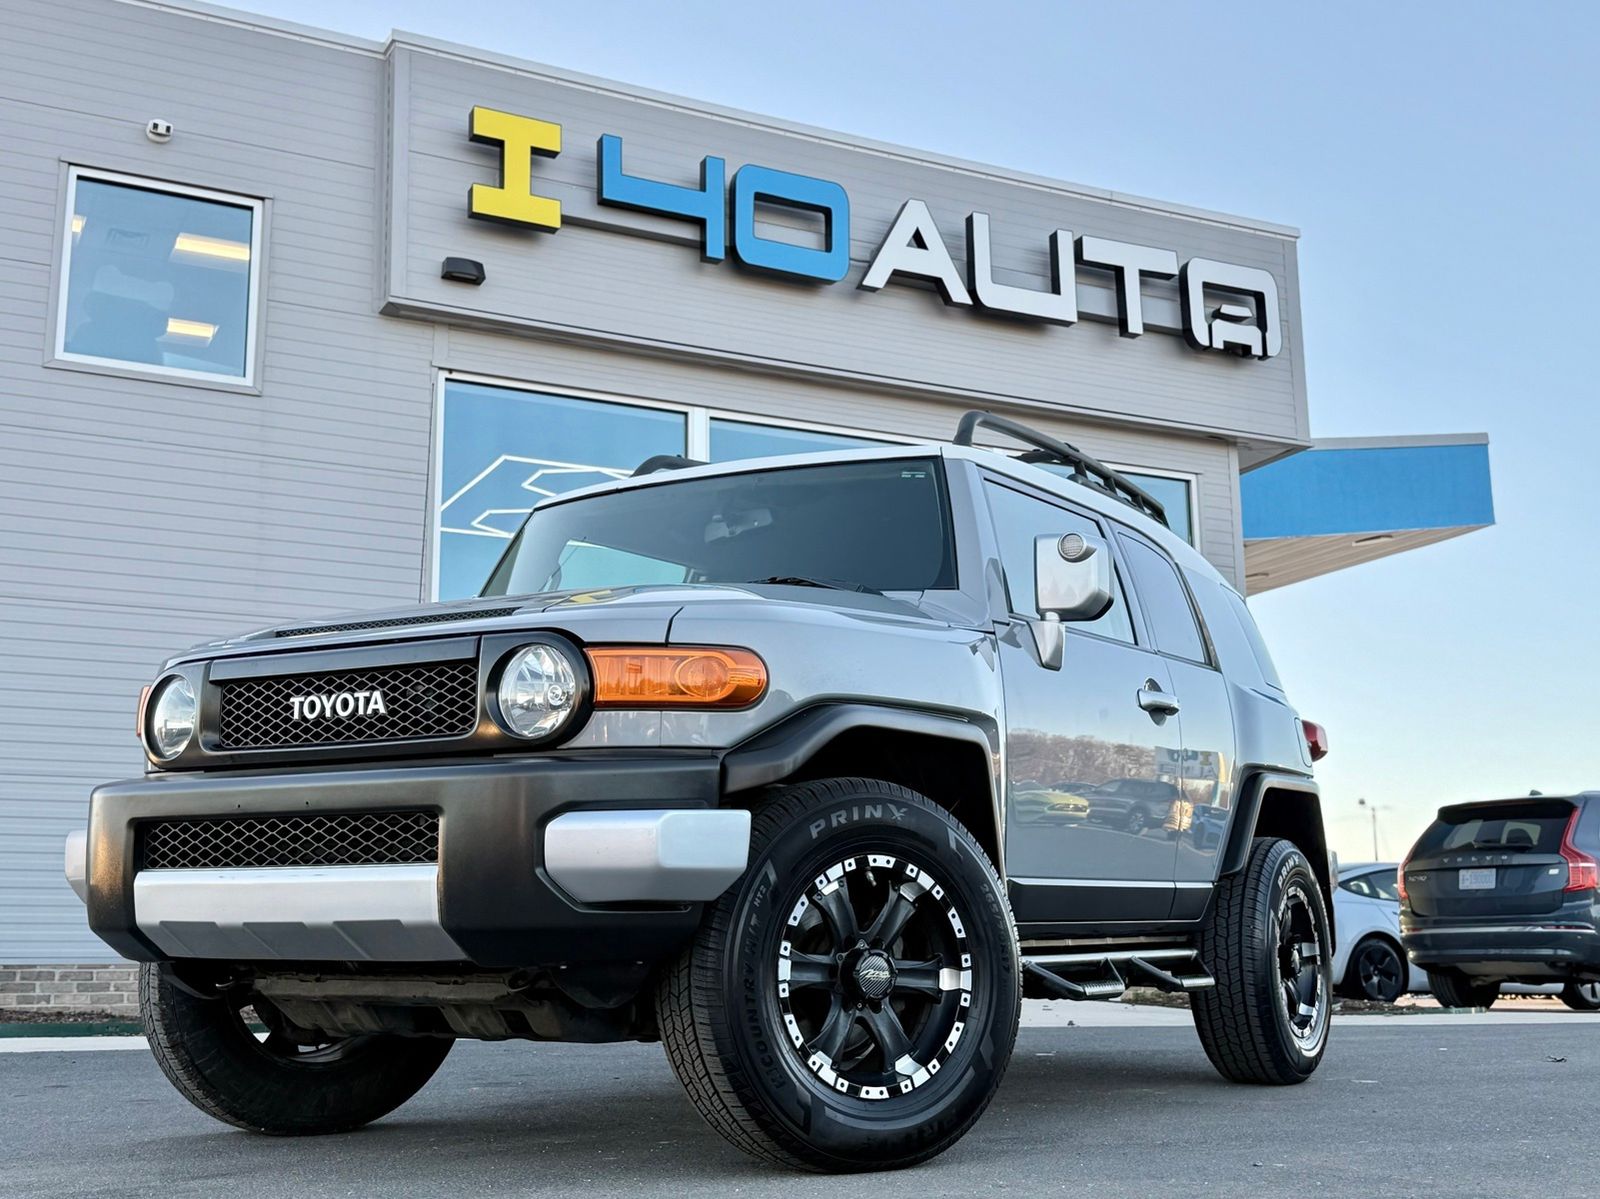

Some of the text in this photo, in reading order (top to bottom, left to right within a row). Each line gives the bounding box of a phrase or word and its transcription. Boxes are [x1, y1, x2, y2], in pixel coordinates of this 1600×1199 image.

[469, 105, 563, 232] I
[597, 133, 850, 284] 40
[290, 690, 388, 720] TOYOTA
[809, 803, 908, 839] PRINX
